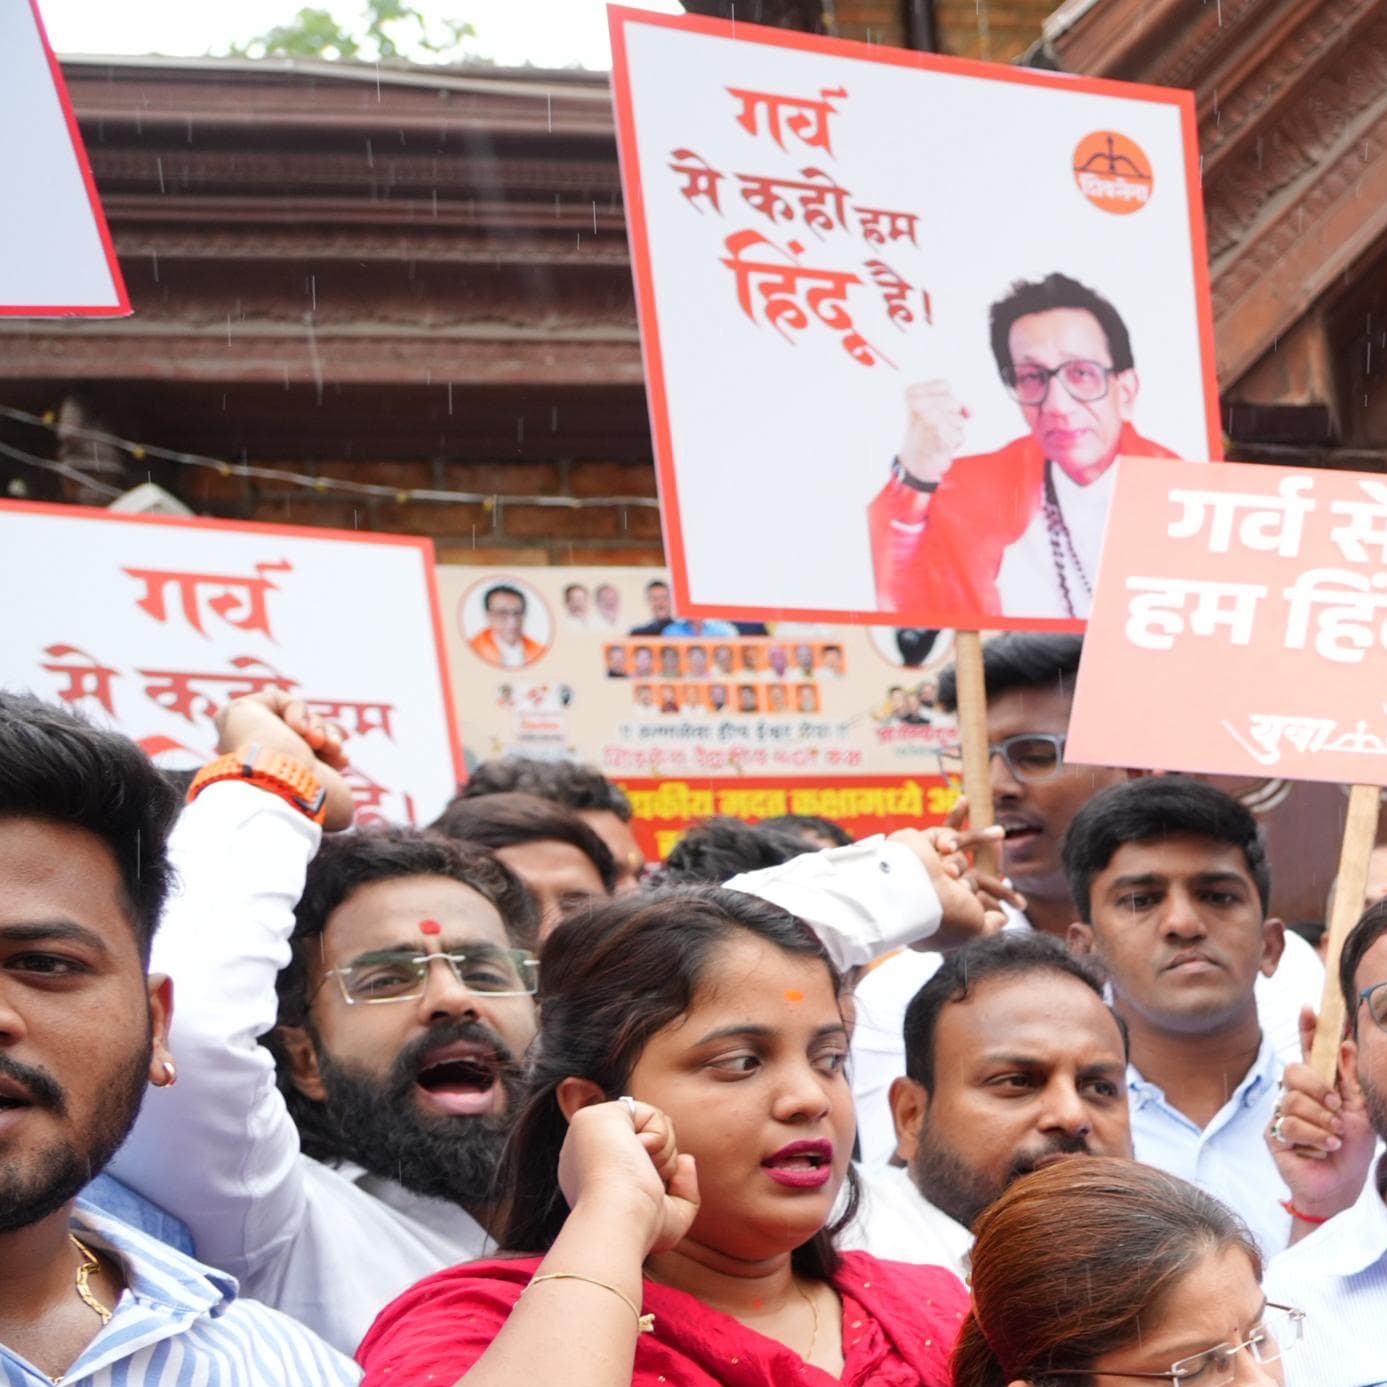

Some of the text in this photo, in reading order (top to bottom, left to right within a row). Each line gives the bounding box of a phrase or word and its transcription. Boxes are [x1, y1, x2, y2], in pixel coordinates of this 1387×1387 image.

[723, 84, 849, 161] गर्व
[668, 148, 922, 253] से कहो हम
[718, 228, 900, 372] हिंदू
[1167, 476, 1316, 558] गर्व
[117, 557, 294, 646] गर्व
[1126, 576, 1267, 650] हम
[36, 644, 121, 721] से
